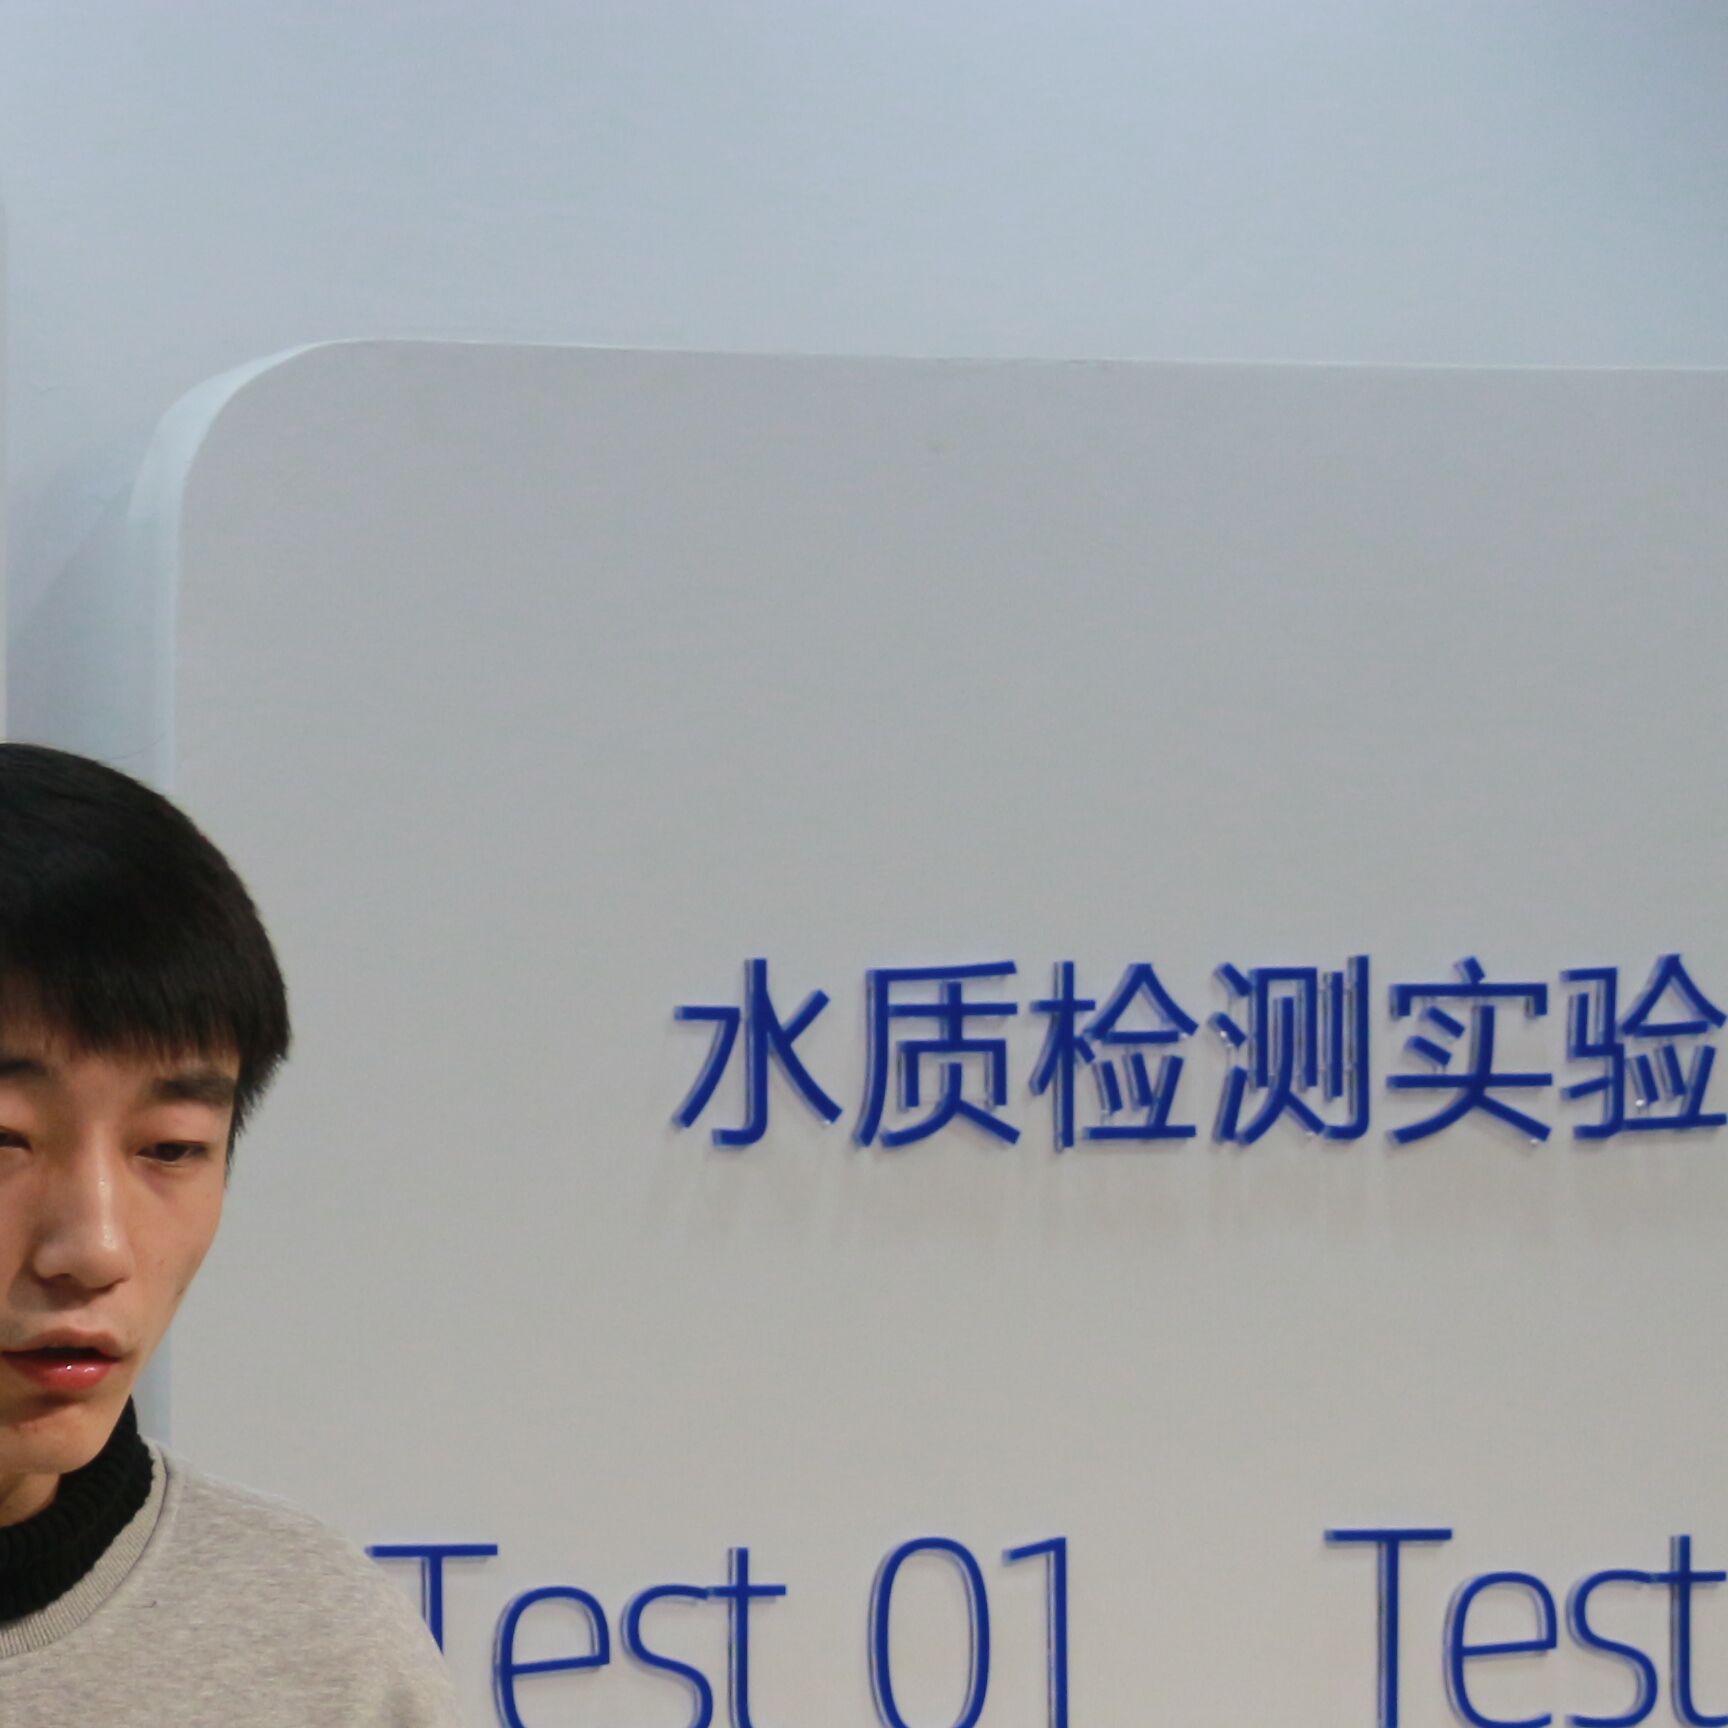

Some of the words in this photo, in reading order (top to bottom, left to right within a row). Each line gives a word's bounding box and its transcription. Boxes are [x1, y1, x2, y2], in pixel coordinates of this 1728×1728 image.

[672, 953, 1728, 1150] 水质检测实验
